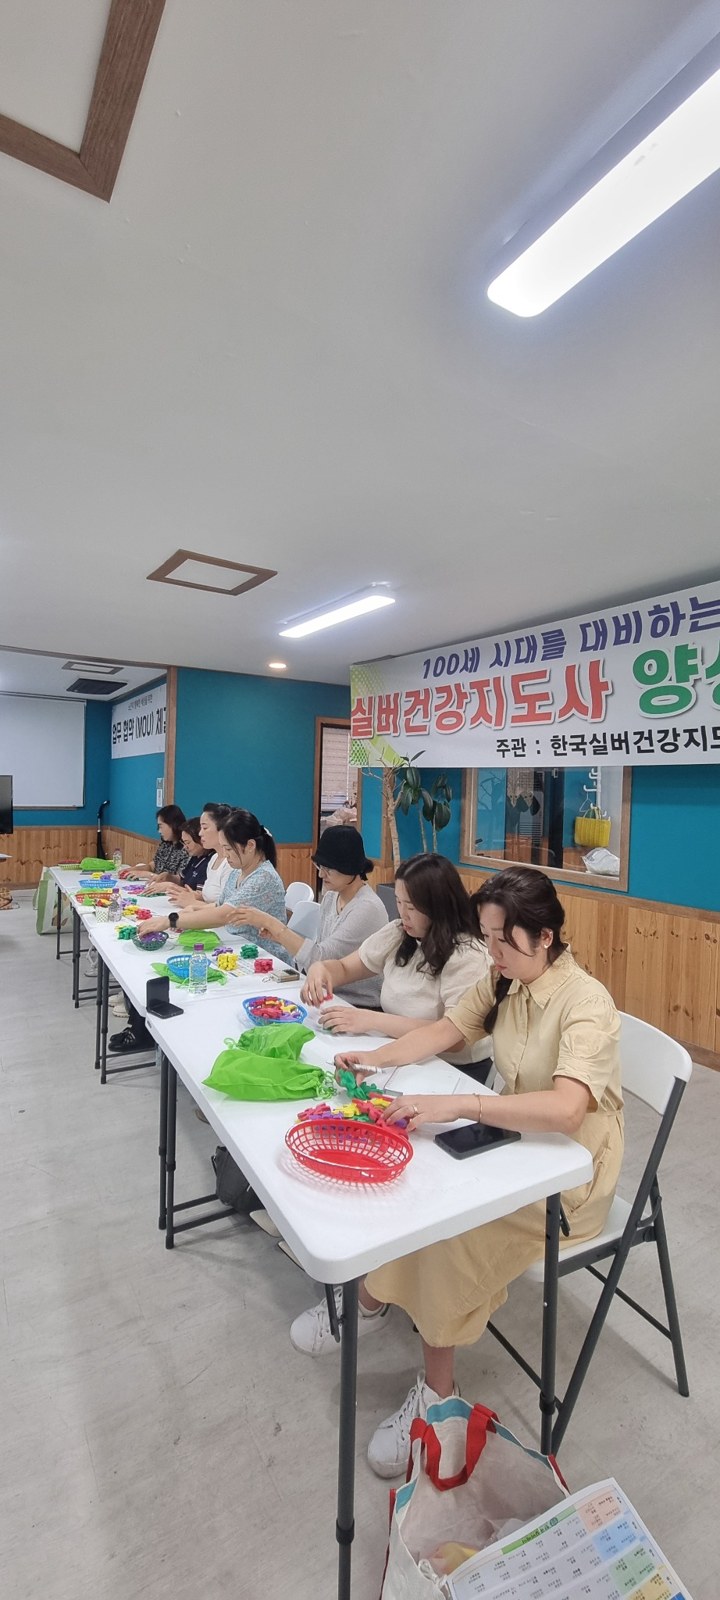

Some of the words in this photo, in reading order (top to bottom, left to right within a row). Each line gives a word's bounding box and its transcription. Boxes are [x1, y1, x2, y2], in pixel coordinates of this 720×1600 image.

[423, 647, 480, 679] 100세
[489, 629, 566, 668] 시대를
[580, 597, 720, 652] 대비하는
[135, 711, 154, 739] (MOU)
[351, 659, 610, 738] 실버건강지도사
[496, 738, 527, 758] 주관
